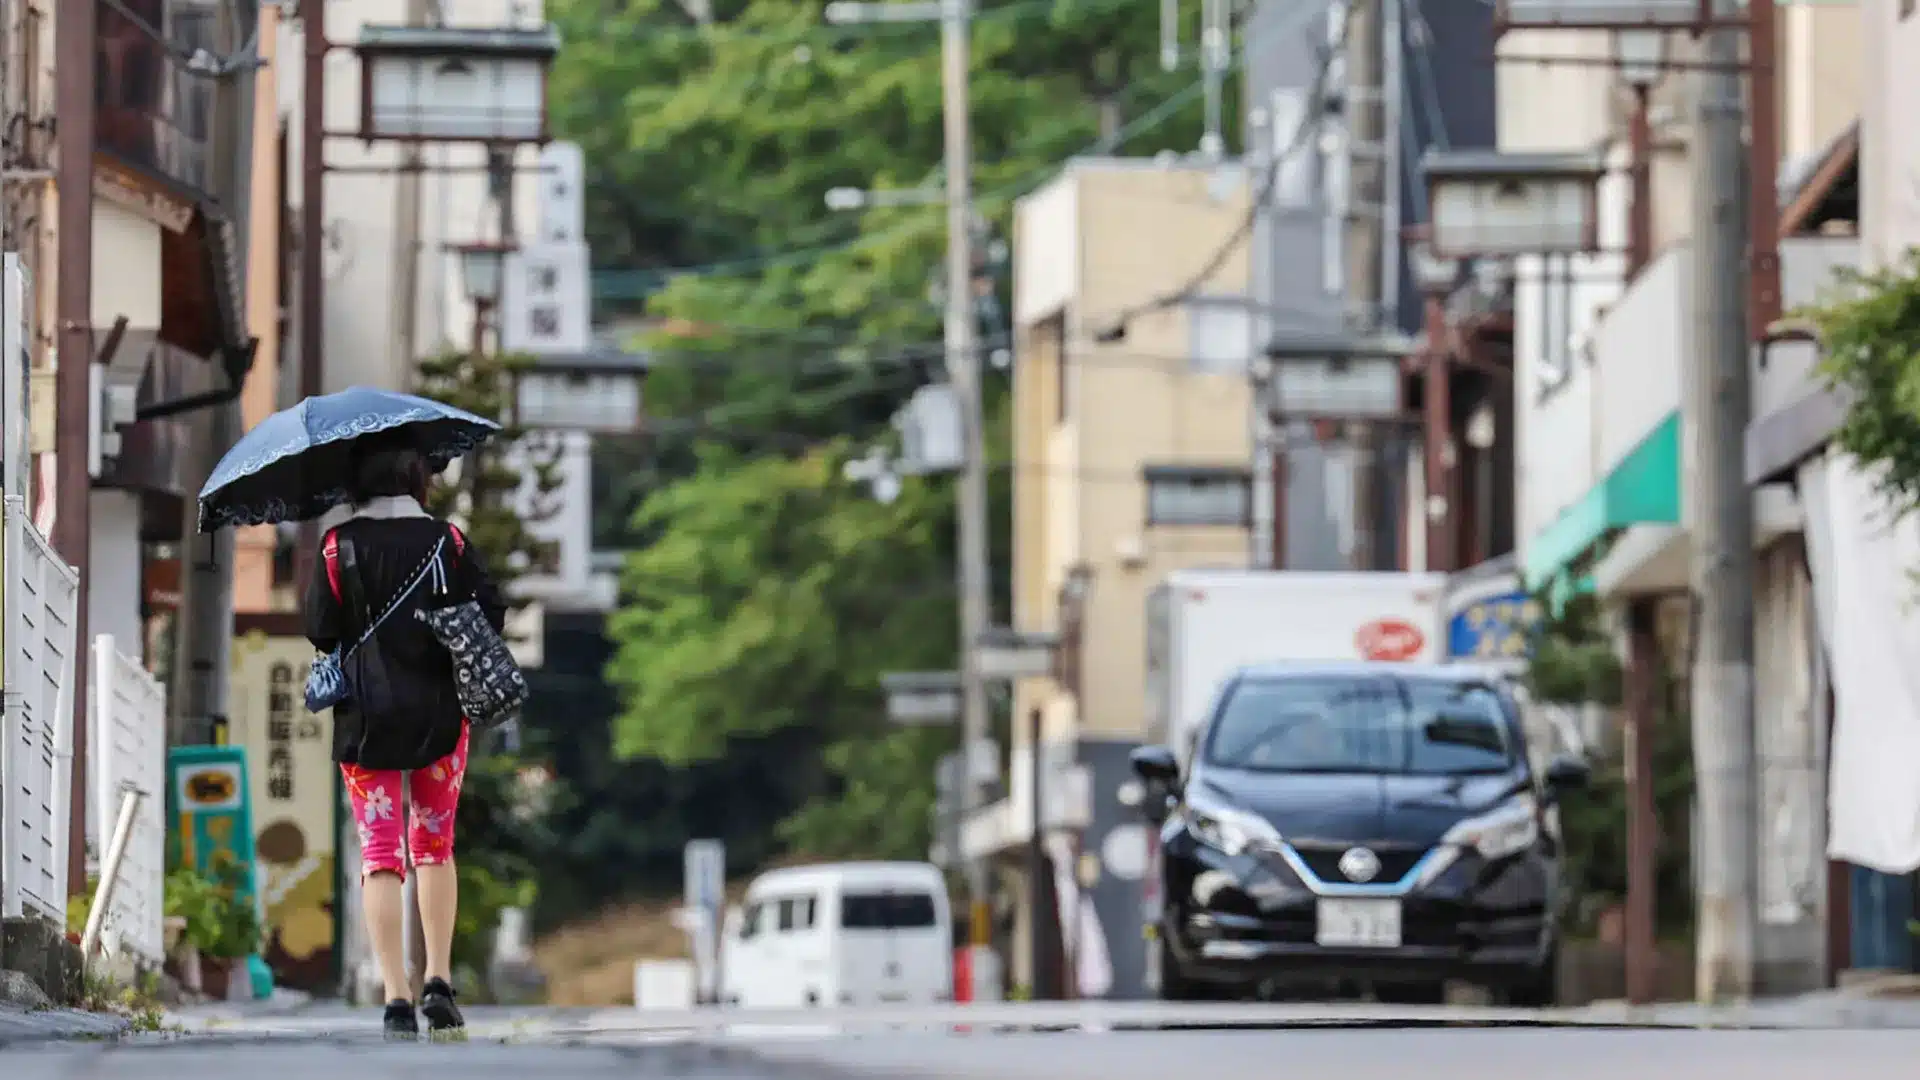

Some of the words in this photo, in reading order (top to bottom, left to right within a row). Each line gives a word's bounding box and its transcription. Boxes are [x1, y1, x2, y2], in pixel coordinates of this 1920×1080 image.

[267, 662, 293, 800] 自動販売機
